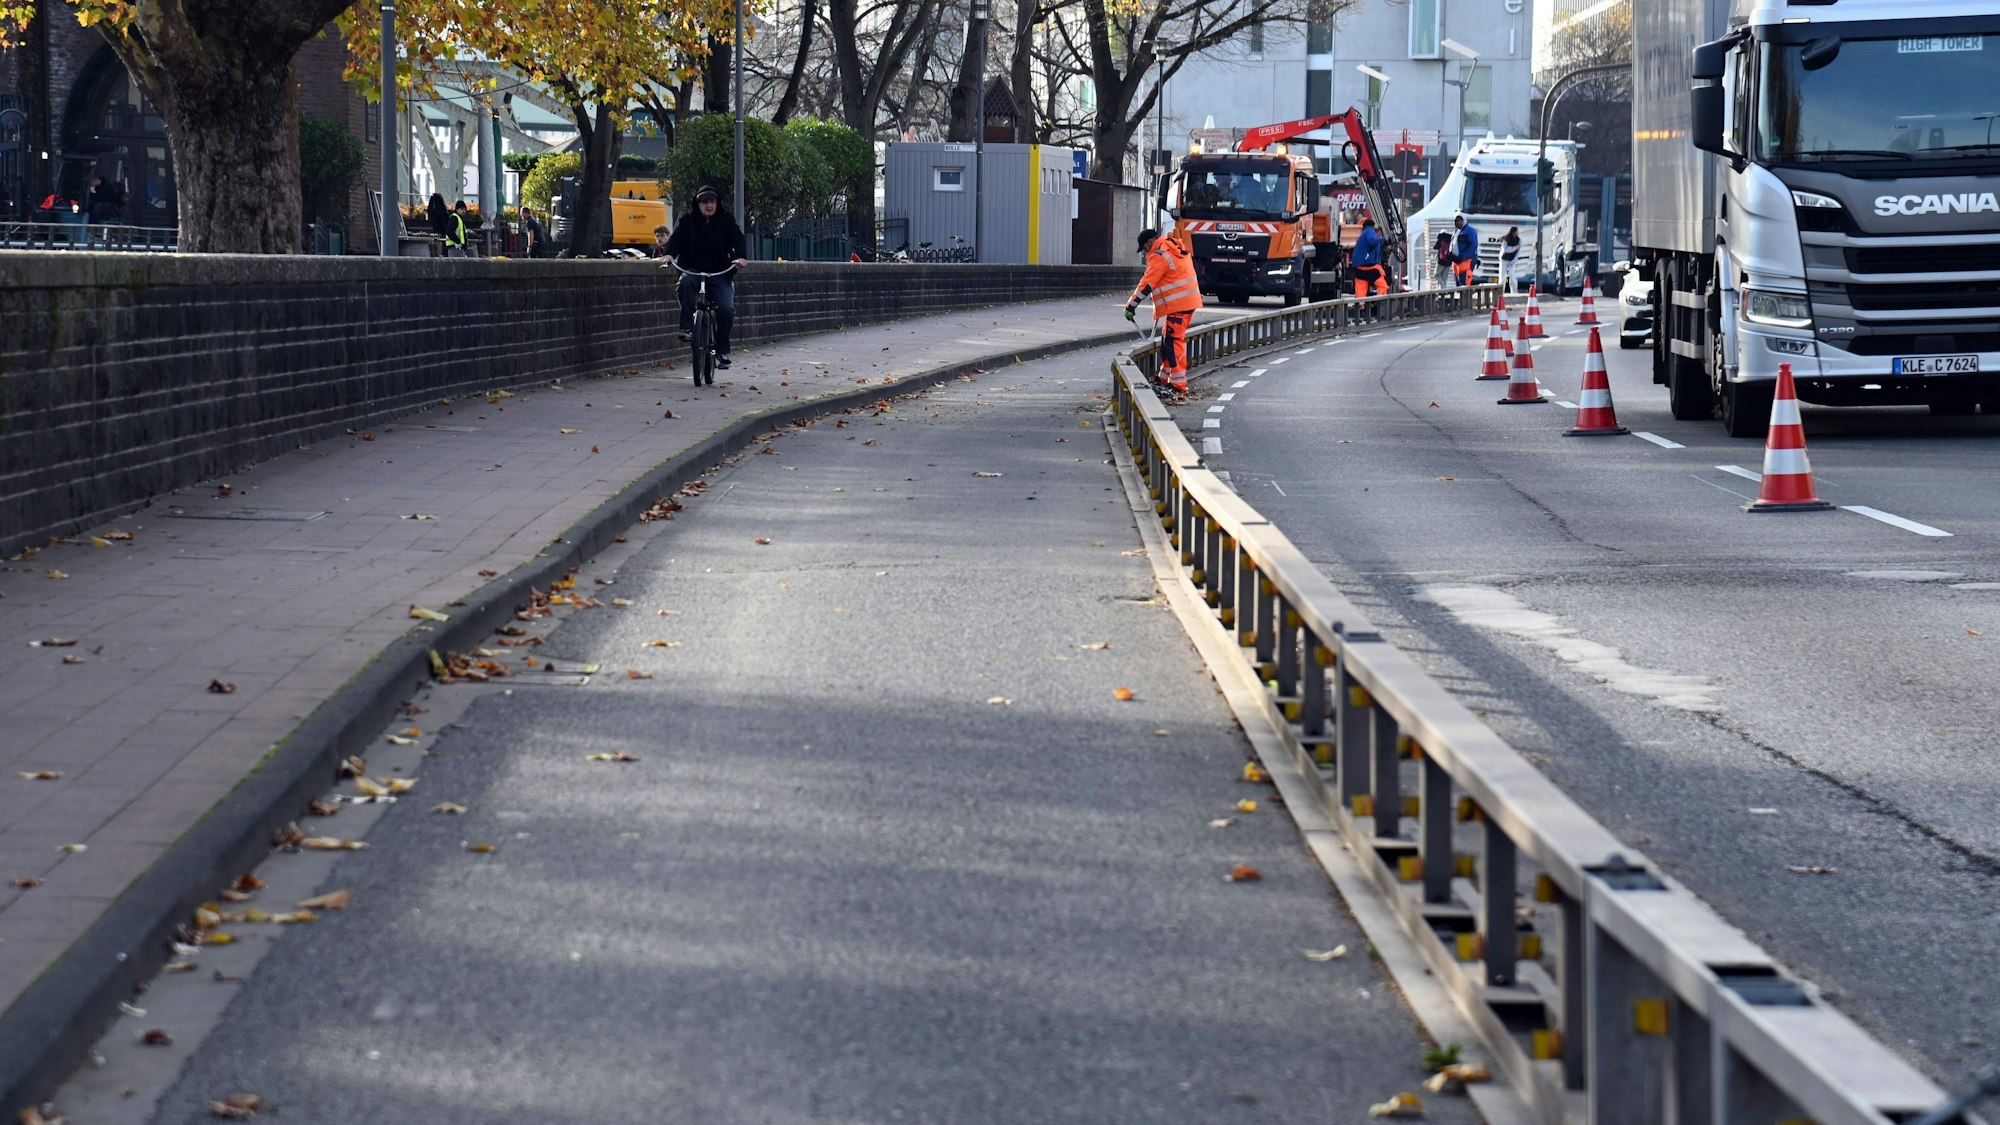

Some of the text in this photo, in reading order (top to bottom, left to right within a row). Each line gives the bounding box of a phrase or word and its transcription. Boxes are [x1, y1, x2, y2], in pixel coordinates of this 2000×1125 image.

[1900, 36, 1979, 51] HIGH-TOWER
[1259, 126, 1284, 135] FASSI
[1874, 192, 2000, 217] SCANIA
[1829, 326, 1854, 334] 320
[1902, 357, 1976, 372] KLE C 7624
